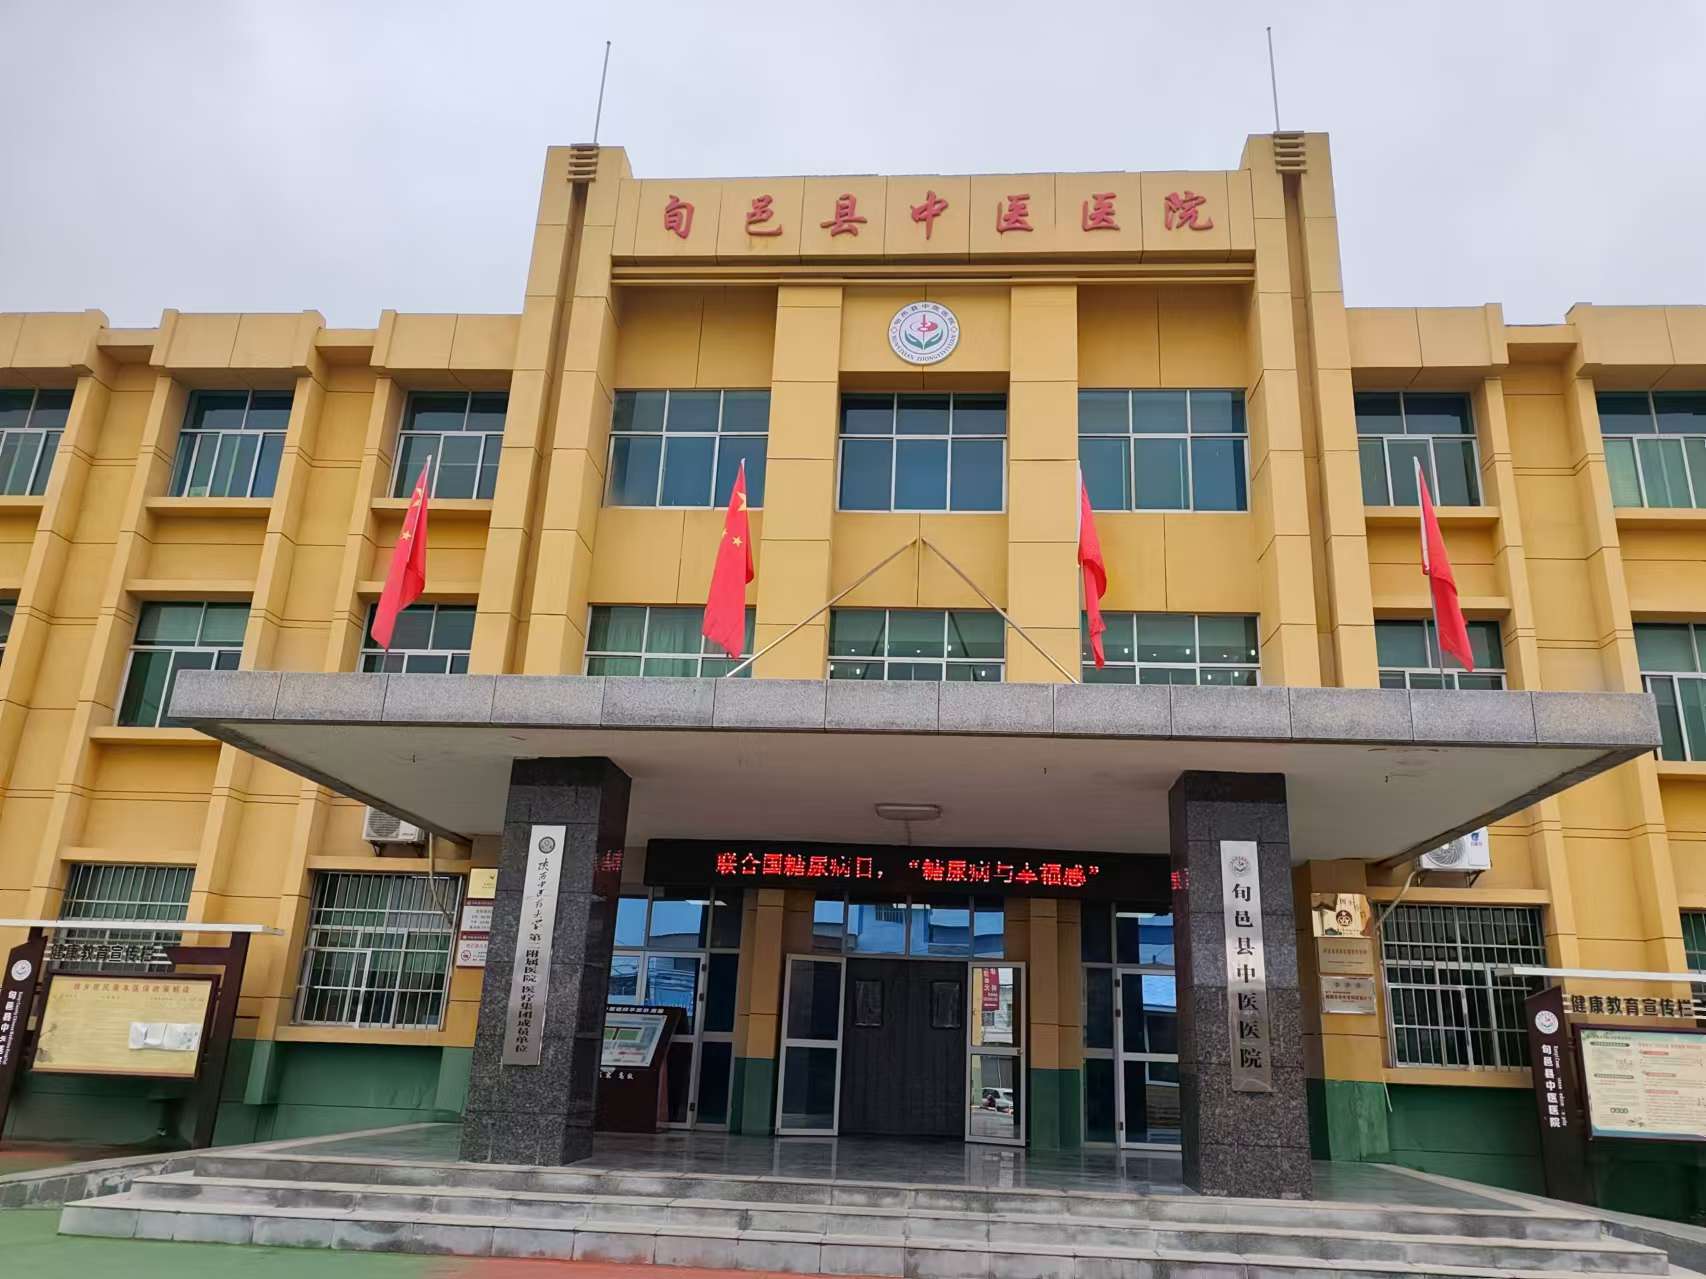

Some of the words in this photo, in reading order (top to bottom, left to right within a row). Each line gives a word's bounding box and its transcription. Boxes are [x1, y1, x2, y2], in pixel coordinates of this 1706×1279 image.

[663, 190, 1214, 240] 旬邑县中医医院
[51, 943, 154, 963] 健康教育宣传栏
[1231, 883, 1263, 1069] 旬邑县中医医院
[1571, 994, 1694, 1018] 健康教育宣传栏
